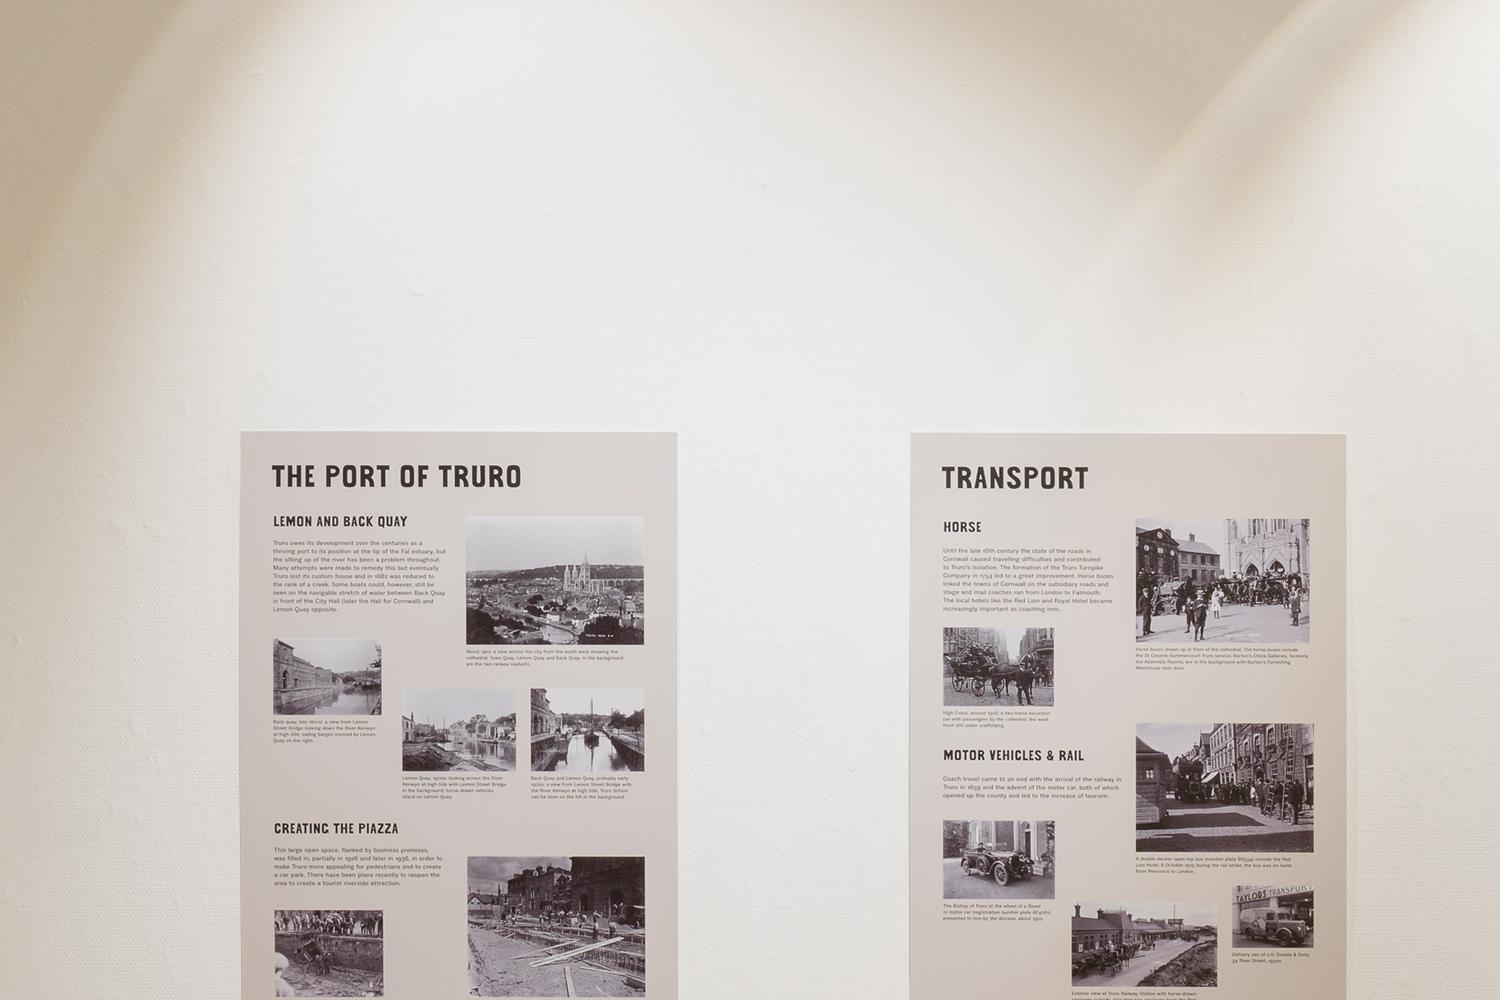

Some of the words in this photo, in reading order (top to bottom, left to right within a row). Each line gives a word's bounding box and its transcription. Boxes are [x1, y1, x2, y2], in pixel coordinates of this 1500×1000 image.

[271, 464, 315, 488] THE
[325, 464, 390, 488] PORT
[400, 464, 429, 488] OF
[438, 464, 521, 488] TRURO
[941, 466, 1089, 490] TRANSPORT
[273, 515, 312, 528] LEMON
[316, 515, 339, 527] AND
[343, 515, 374, 528] BACK
[377, 515, 408, 529] QUAY
[943, 521, 982, 533] HORSE
[943, 749, 986, 761] MOTOR
[989, 749, 1042, 762] VEHICLES
[1046, 749, 1055, 762] &
[1058, 749, 1085, 762] RAIL
[274, 822, 330, 835] CREATING
[332, 822, 355, 835] THE
[358, 822, 399, 835] PIAZZA
[1236, 890, 1267, 903] TAYLORS
